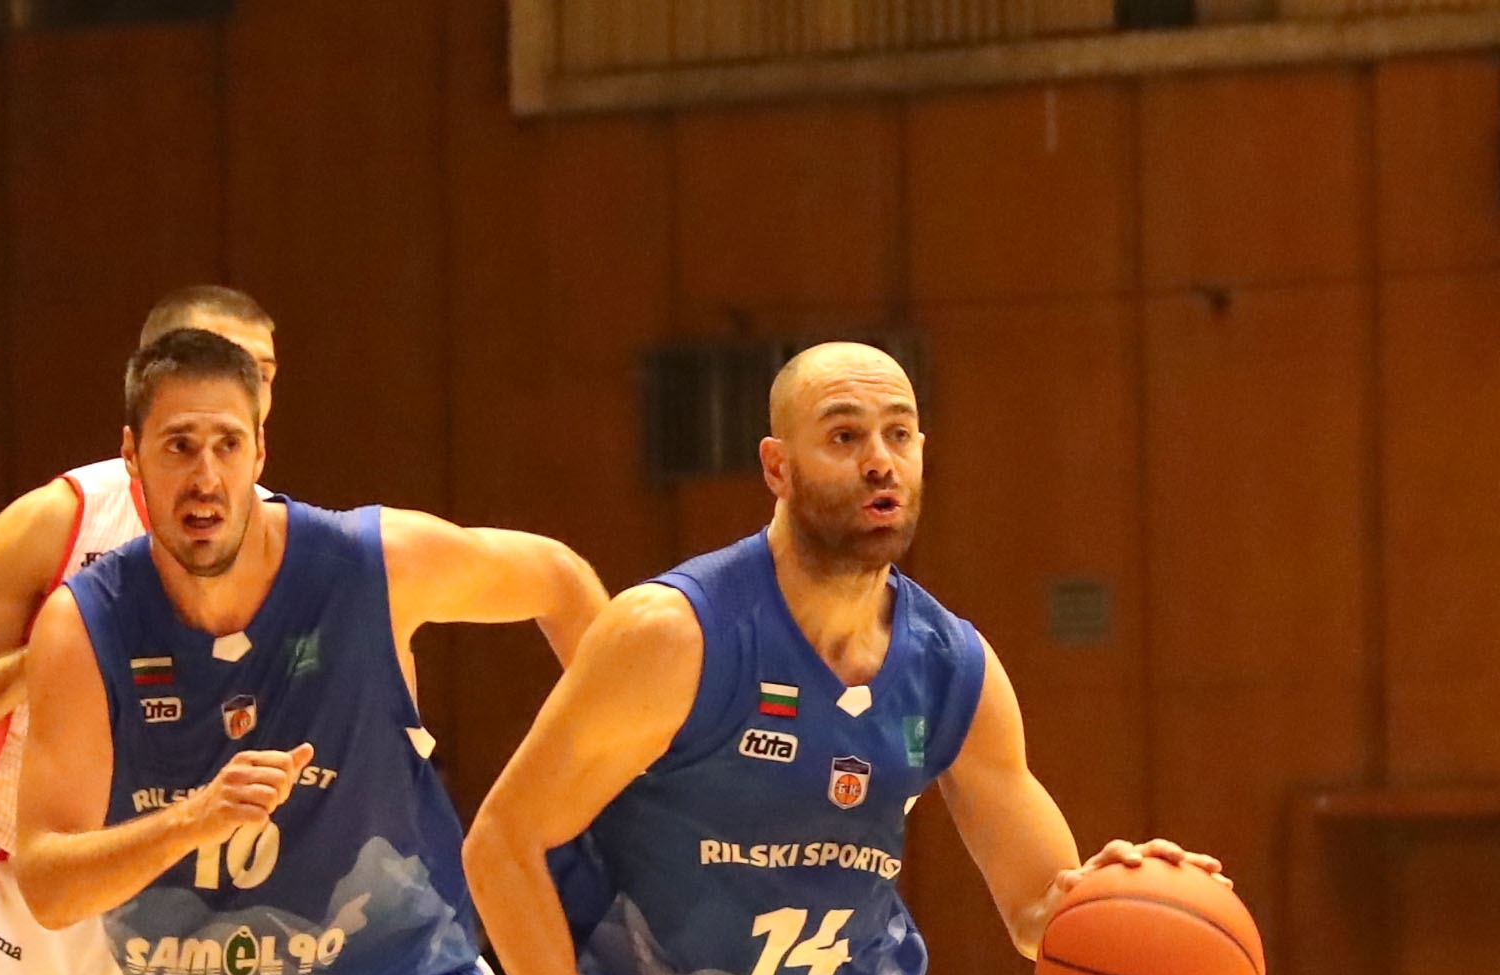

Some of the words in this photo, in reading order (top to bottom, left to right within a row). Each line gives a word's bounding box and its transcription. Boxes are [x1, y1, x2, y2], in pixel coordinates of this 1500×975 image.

[194, 817, 280, 890] 10
[700, 839, 800, 868] RILSKI
[288, 927, 346, 974] 90
